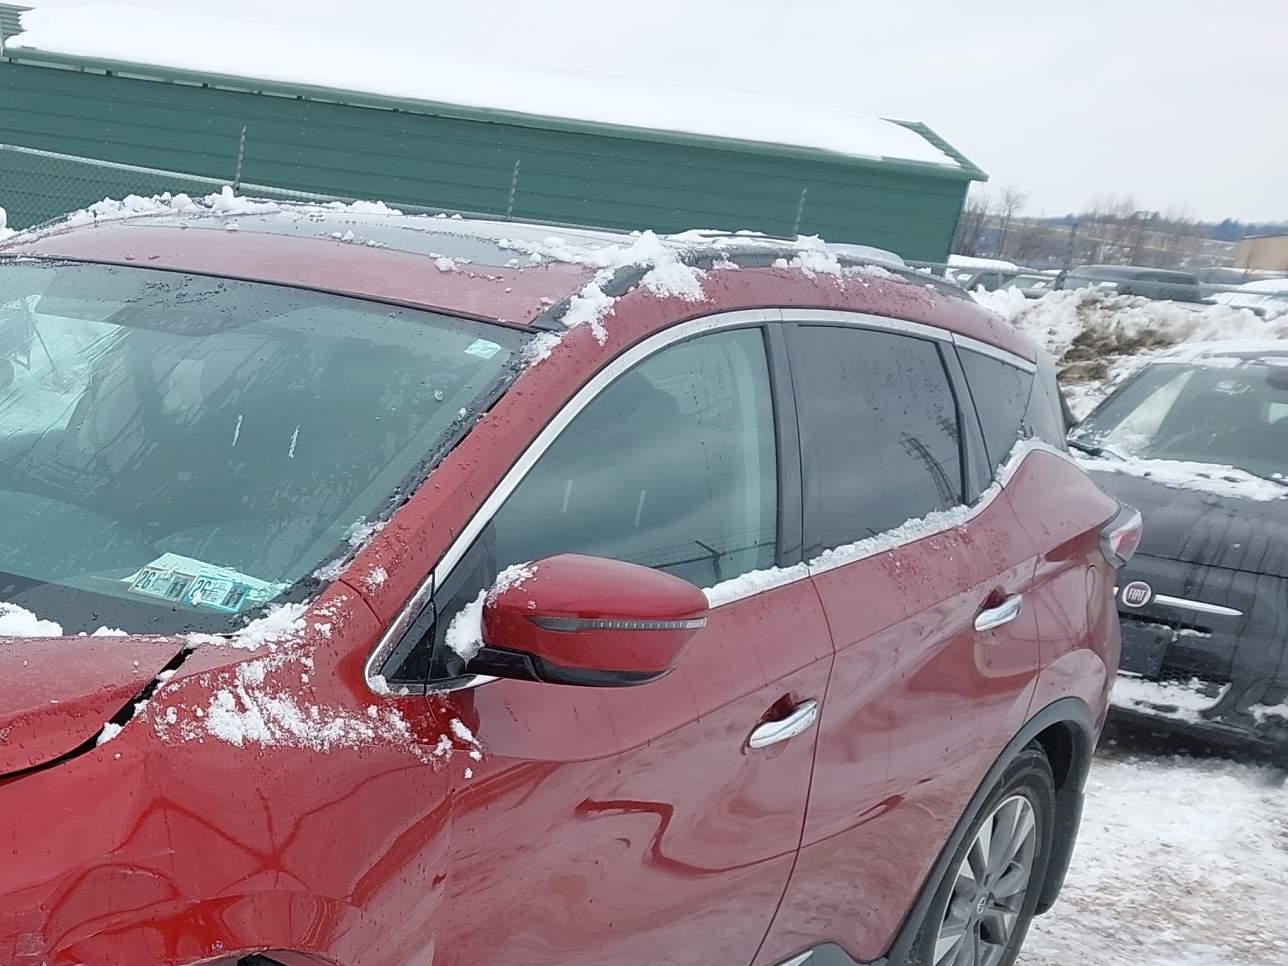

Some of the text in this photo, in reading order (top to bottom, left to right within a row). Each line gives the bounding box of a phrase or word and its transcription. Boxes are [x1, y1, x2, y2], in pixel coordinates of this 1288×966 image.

[134, 570, 157, 590] 26
[191, 580, 211, 600] 26
[1128, 588, 1147, 601] FIAT
